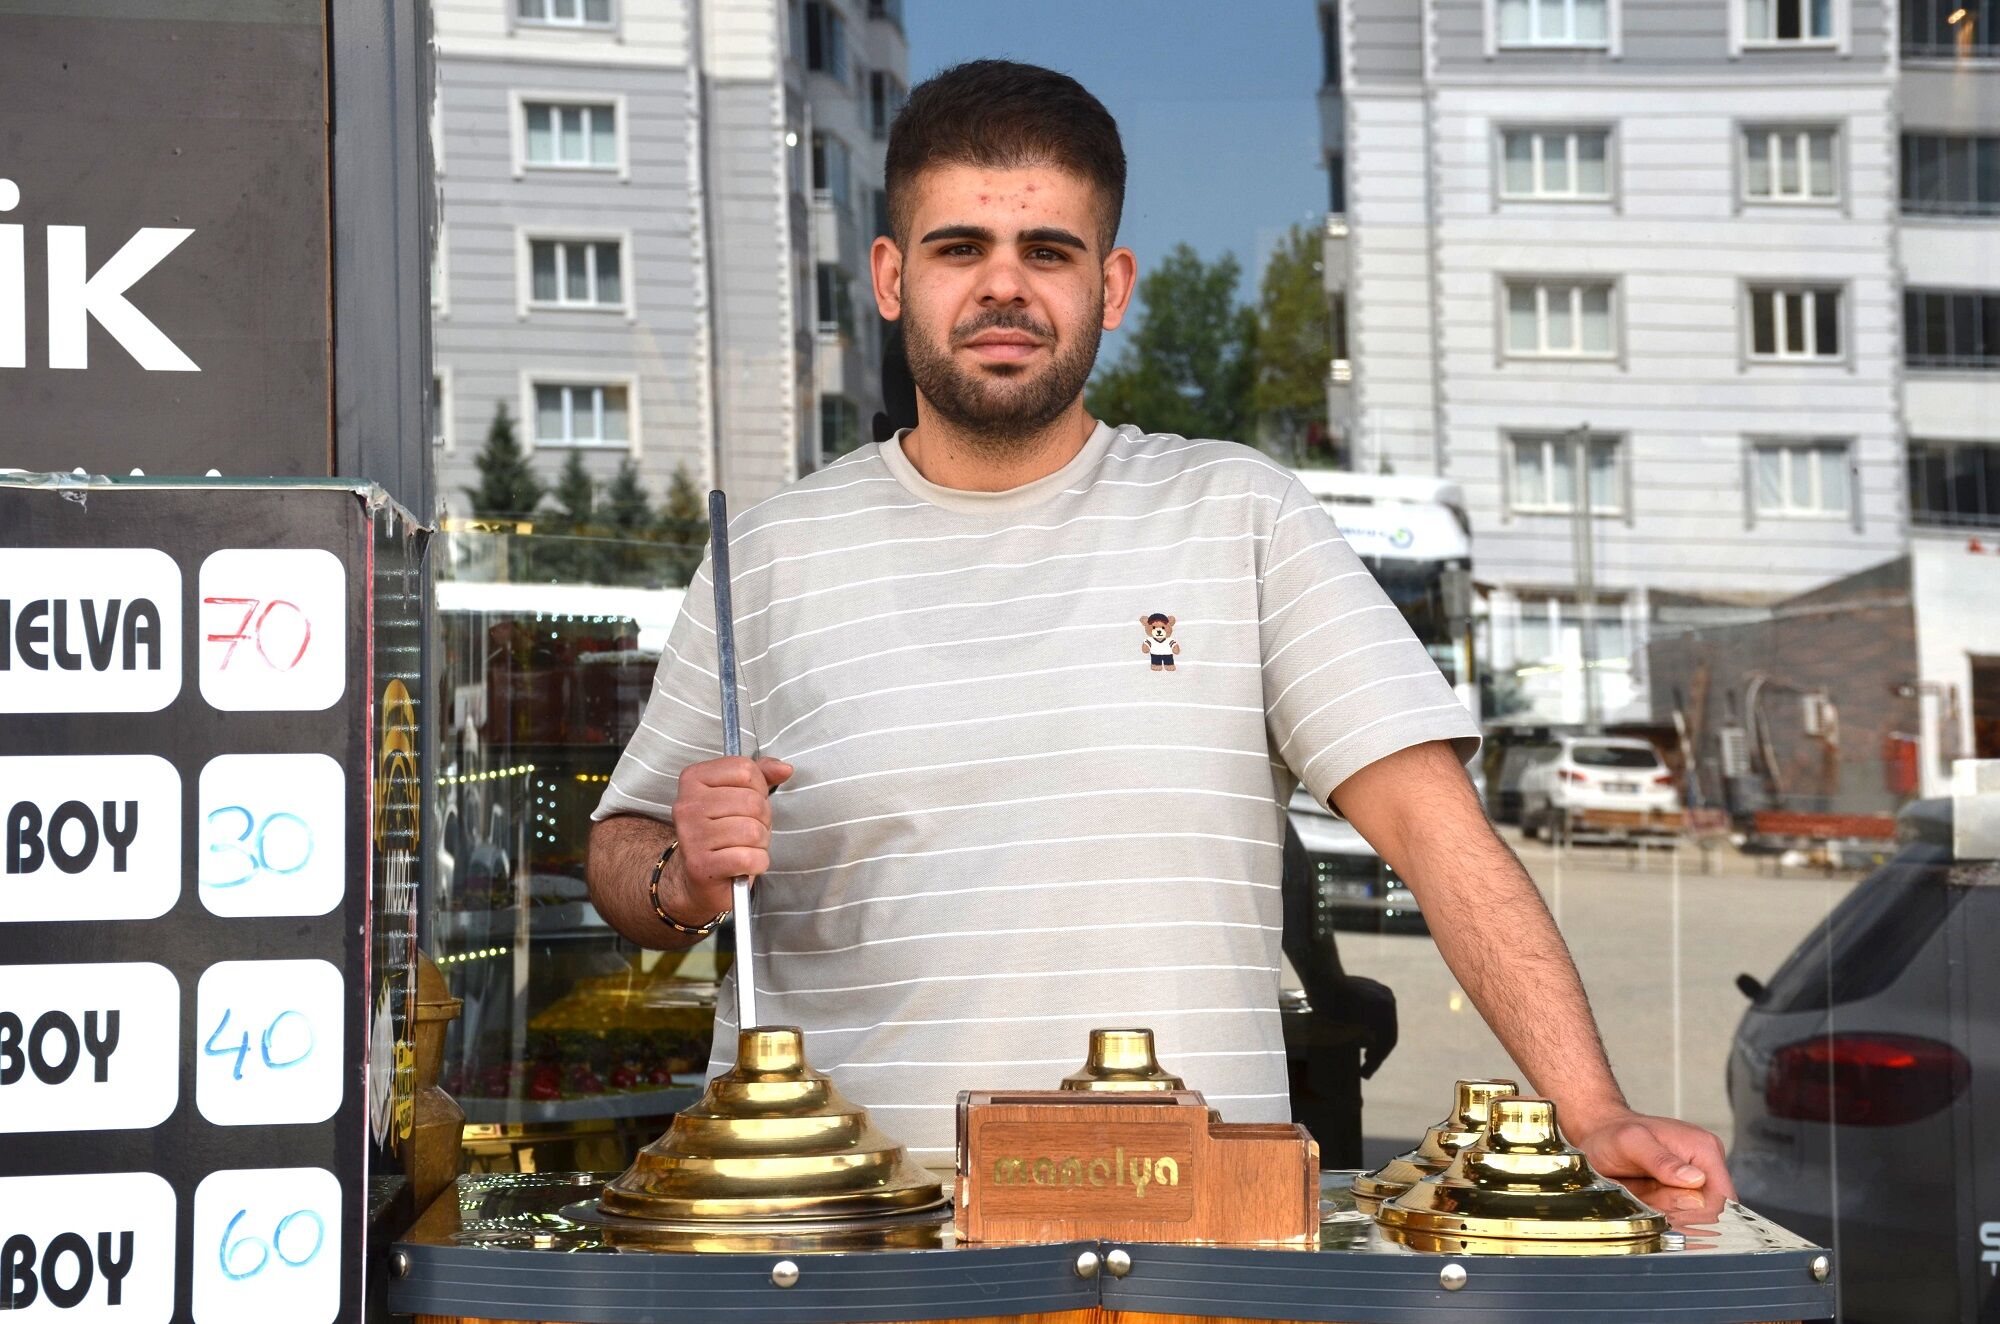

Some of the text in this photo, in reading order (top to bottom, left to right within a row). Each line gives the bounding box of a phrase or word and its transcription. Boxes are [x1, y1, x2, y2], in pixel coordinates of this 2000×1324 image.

[203, 597, 312, 671] 70
[7, 800, 138, 875] BOY
[201, 805, 315, 889] 30
[0, 1010, 120, 1085] BOY
[203, 1008, 315, 1081] 40
[993, 1147, 1180, 1197] manolya
[0, 1230, 134, 1309] BOY
[219, 1209, 326, 1282] 60
